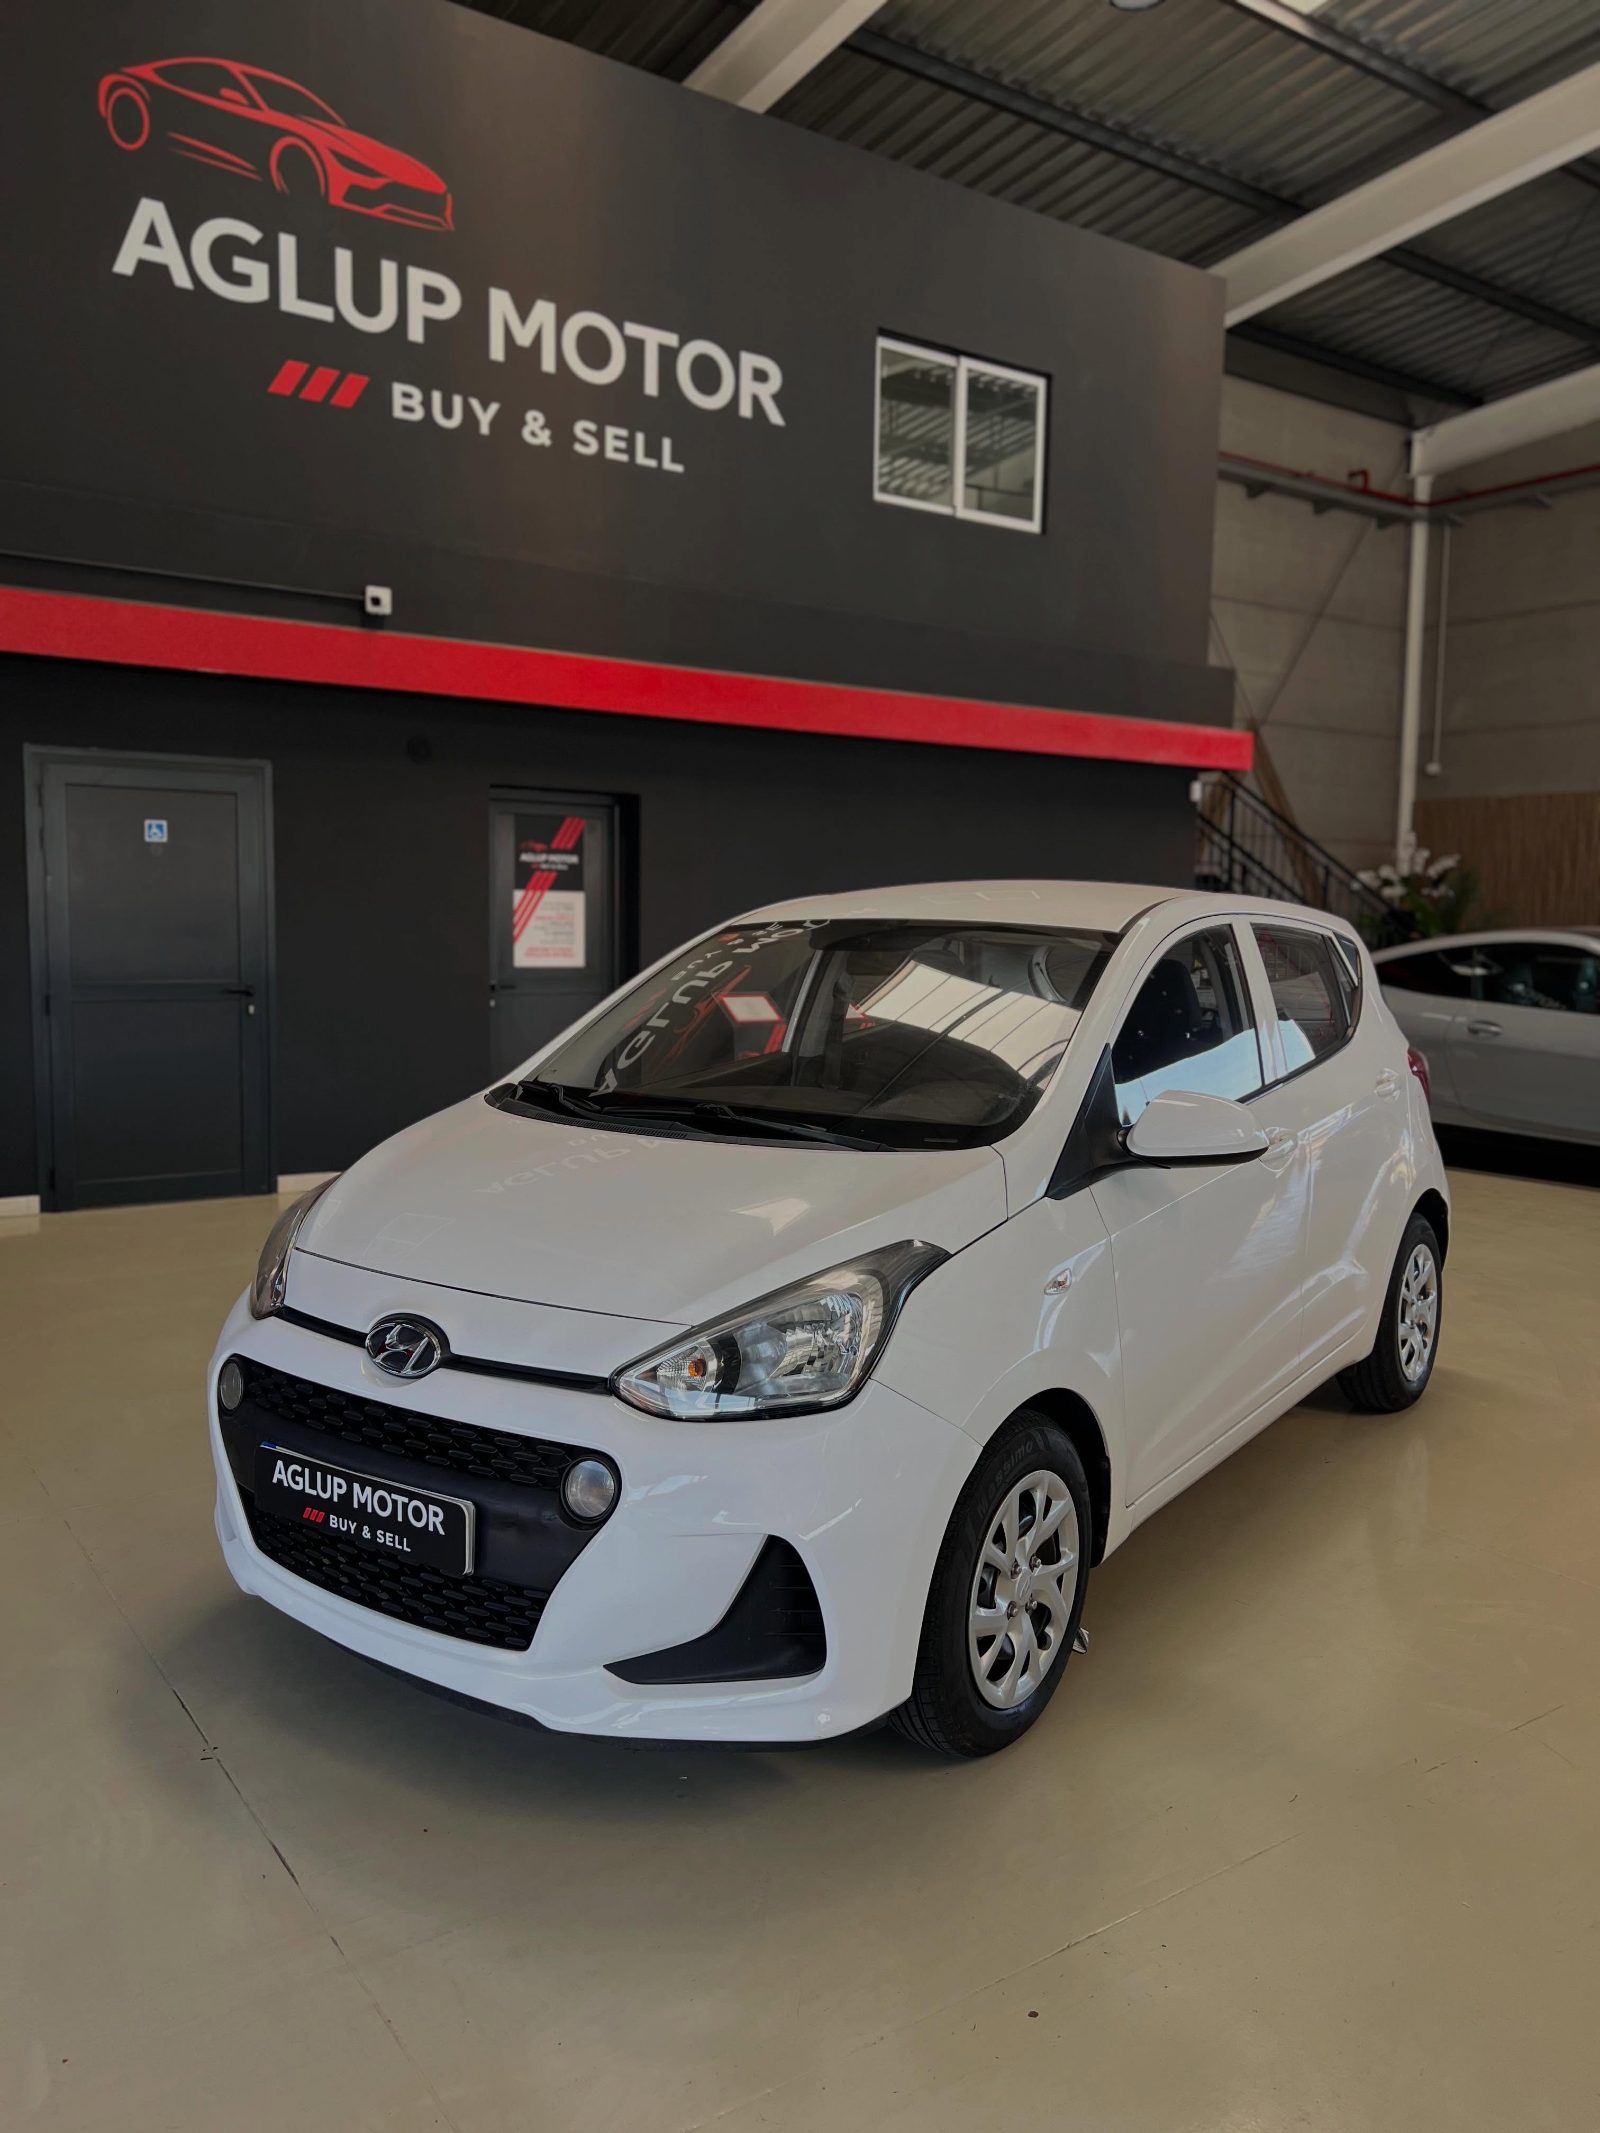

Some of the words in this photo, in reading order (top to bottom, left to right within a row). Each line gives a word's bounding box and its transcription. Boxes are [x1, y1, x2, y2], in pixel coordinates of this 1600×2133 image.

[112, 197, 462, 344] AGLUP
[488, 286, 786, 427] MOTOR
[391, 382, 500, 436] BUY
[521, 409, 552, 447] &
[573, 420, 685, 473] SELL
[272, 1459, 347, 1502] AGLUP
[353, 1482, 445, 1535] MOTOR
[329, 1514, 357, 1534] BUY
[362, 1525, 371, 1539] &
[376, 1529, 411, 1552] SELL
